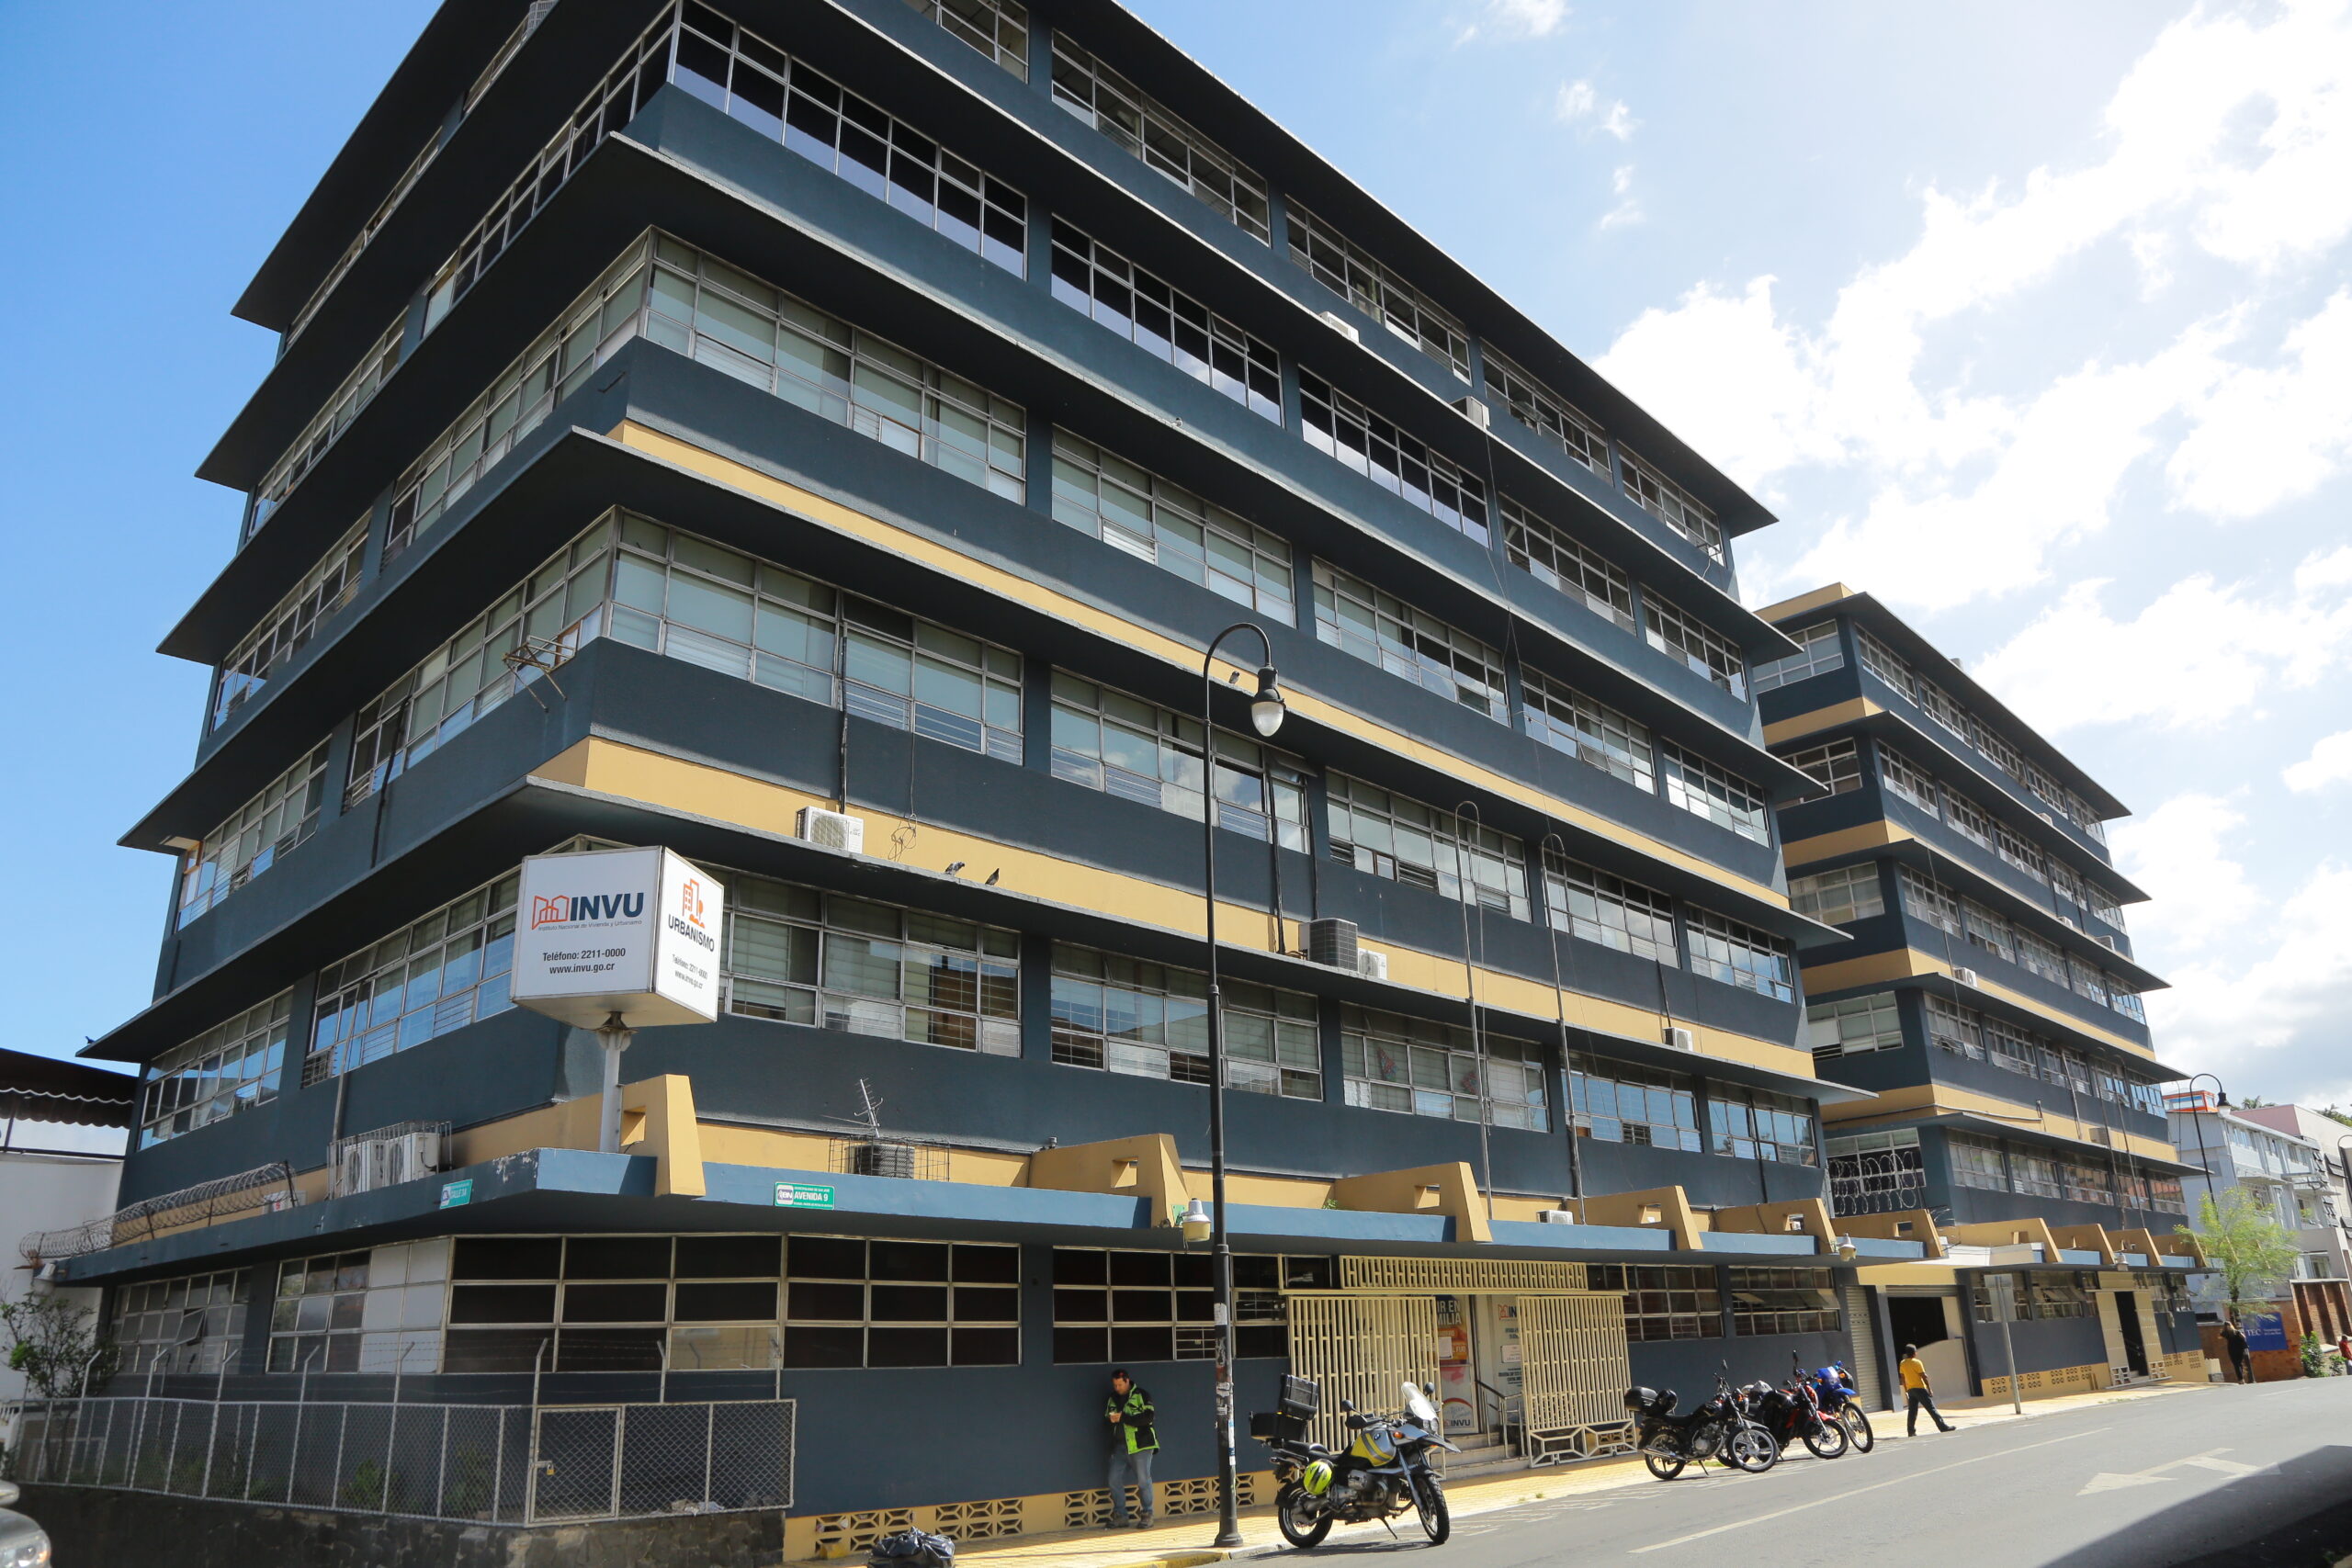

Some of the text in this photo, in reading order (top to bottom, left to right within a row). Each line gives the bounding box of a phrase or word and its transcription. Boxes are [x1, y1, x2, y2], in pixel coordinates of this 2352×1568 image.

[570, 892, 644, 921] INVU
[668, 913, 715, 953] URBANISMO
[542, 947, 626, 962] Teléfono: 2211-0000
[549, 963, 616, 975] www.invu.go.cr
[794, 1191, 829, 1201] AVENIDA 9
[1448, 1300, 1461, 1313] EN
[1438, 1313, 1462, 1325] MILIA
[2246, 1328, 2262, 1337] TEC
